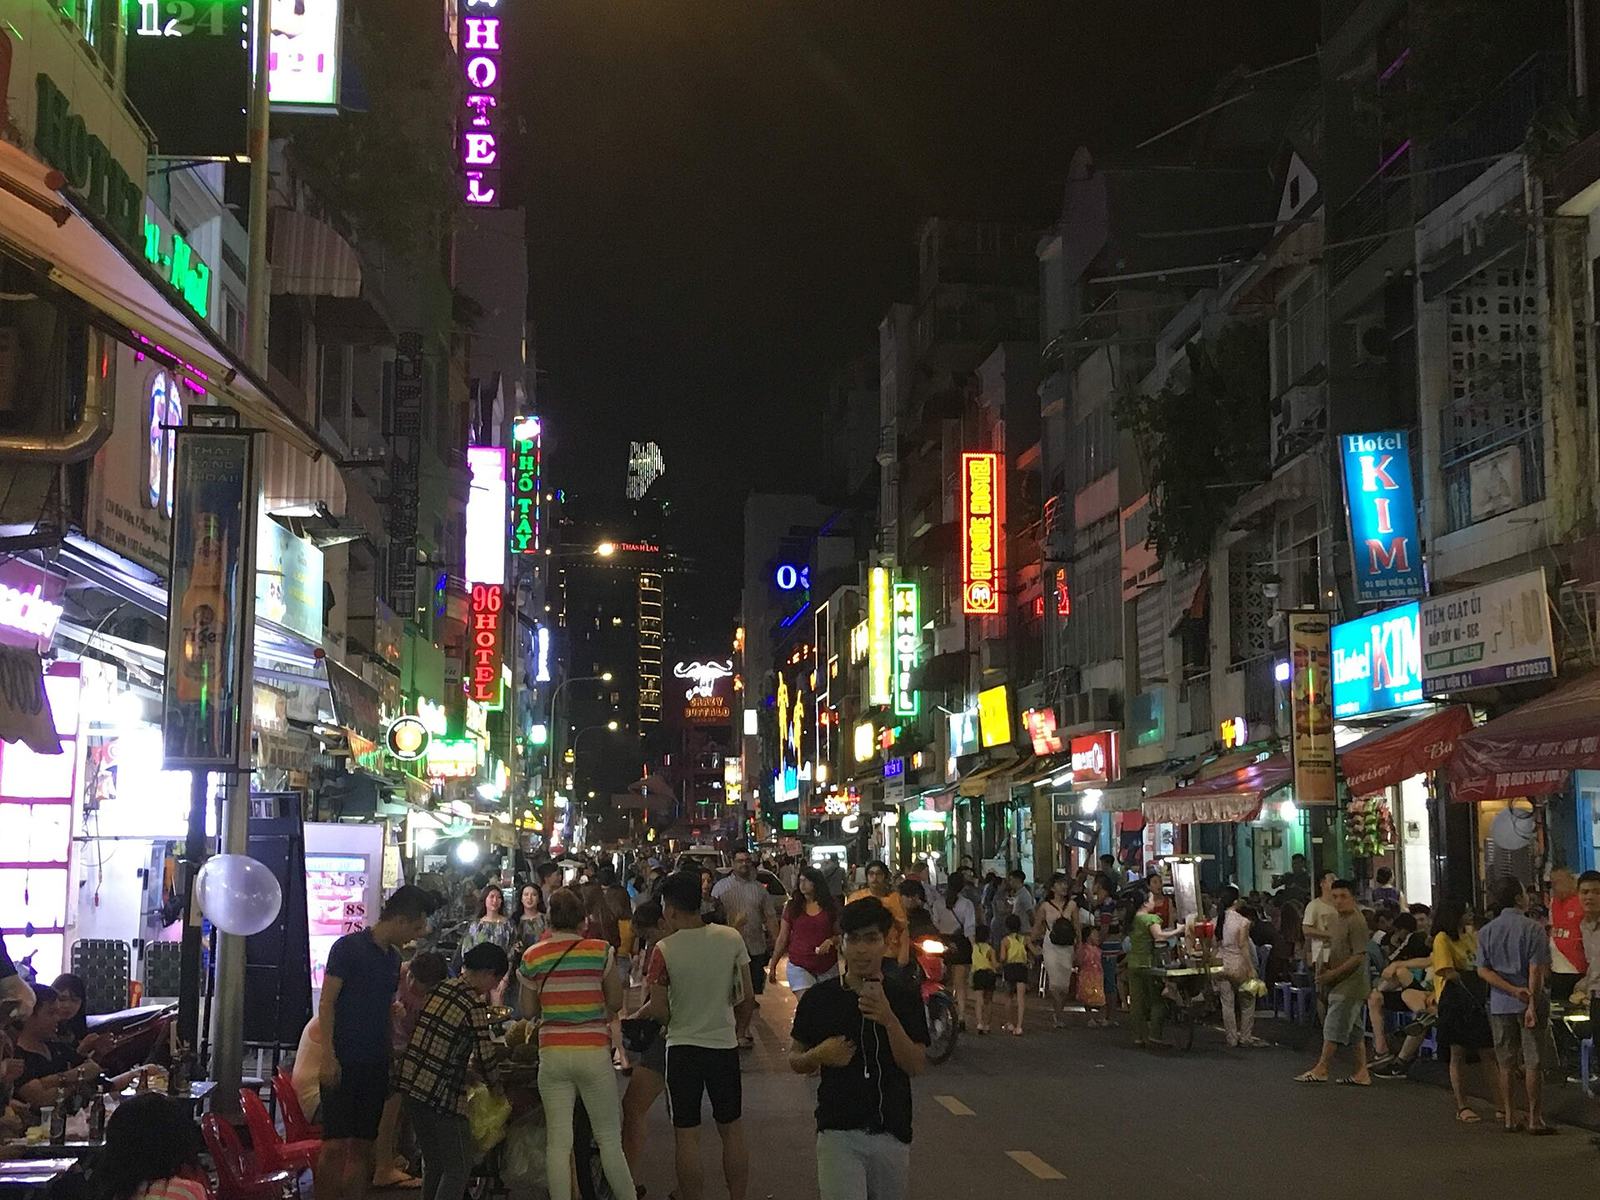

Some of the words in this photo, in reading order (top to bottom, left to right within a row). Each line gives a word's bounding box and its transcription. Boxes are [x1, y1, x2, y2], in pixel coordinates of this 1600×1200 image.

[464, 18, 500, 203] HOTEL
[1348, 433, 1403, 453] Hotel
[1359, 454, 1412, 575] KIM
[472, 585, 502, 612] 96
[474, 613, 497, 700] HOTEL
[896, 615, 916, 710] HOTEL
[1332, 642, 1371, 685] Hotel
[1370, 611, 1422, 691] KIM
[346, 904, 365, 916] 8$
